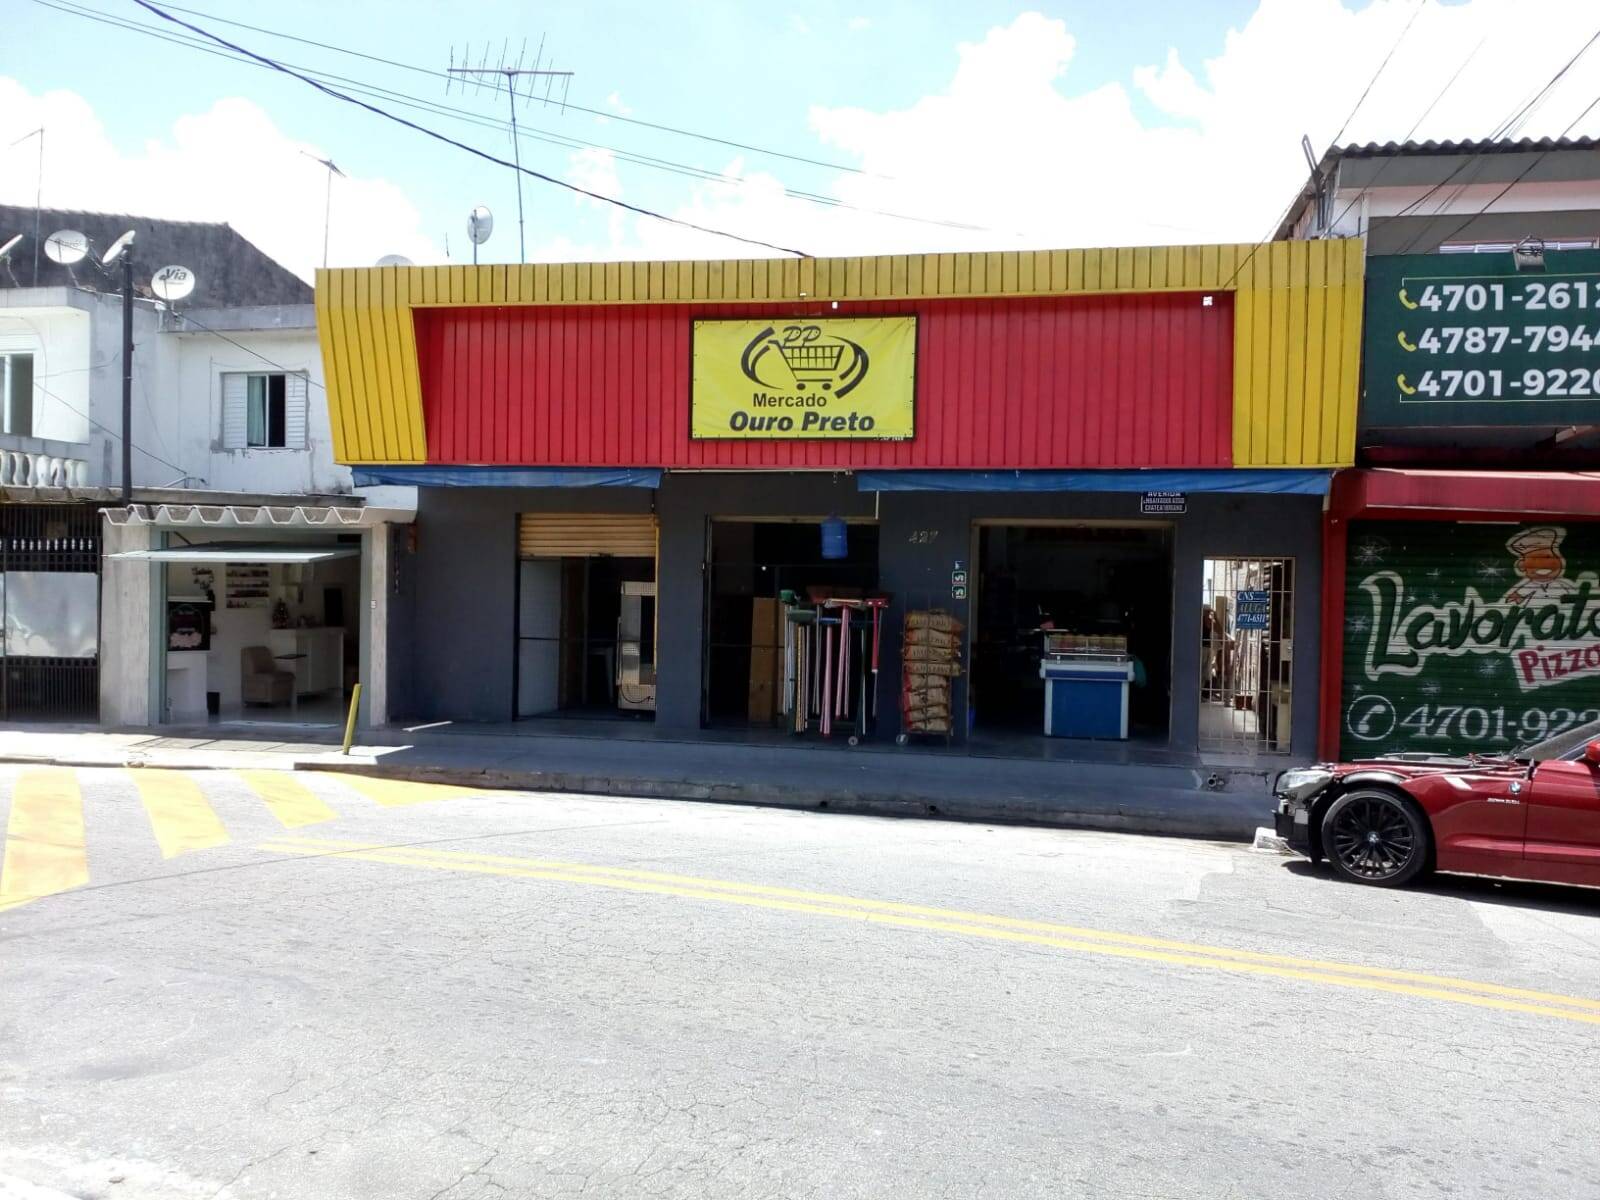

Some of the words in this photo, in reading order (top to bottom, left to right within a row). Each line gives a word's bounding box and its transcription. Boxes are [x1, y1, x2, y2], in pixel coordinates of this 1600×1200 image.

[1419, 282, 1600, 312] 4701-261
[753, 393, 827, 407] Mercado
[729, 411, 793, 431] Ouro
[801, 411, 875, 431] Preto
[1237, 592, 1254, 601] CNS
